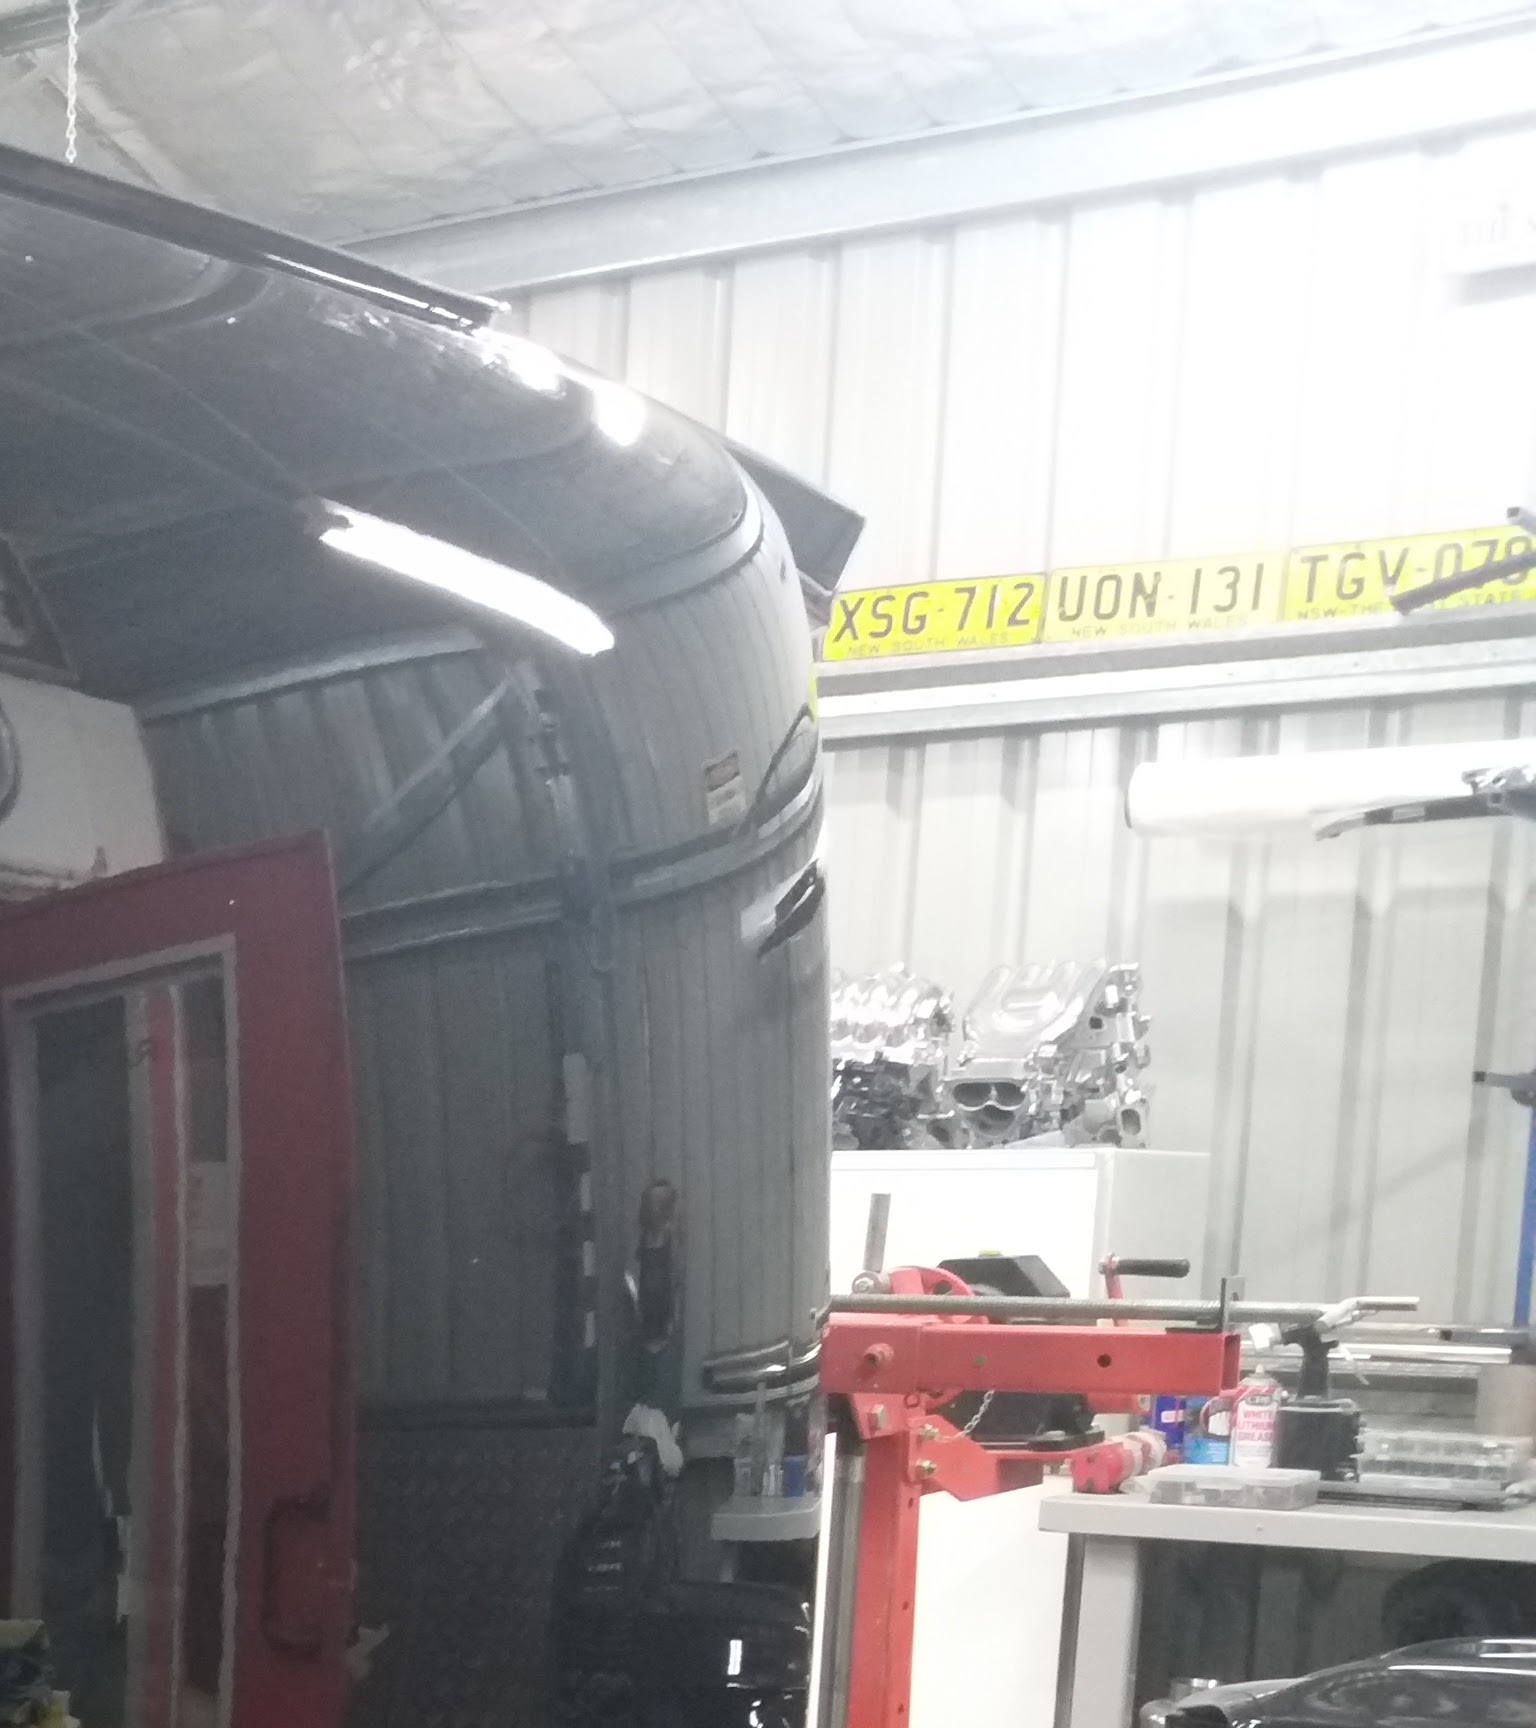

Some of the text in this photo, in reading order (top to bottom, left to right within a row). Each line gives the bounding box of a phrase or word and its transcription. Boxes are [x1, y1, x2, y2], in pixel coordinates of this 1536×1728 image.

[1071, 615, 1248, 638] NEW SOUTH WALES
[848, 631, 1009, 656] NEW SOUTH WALES
